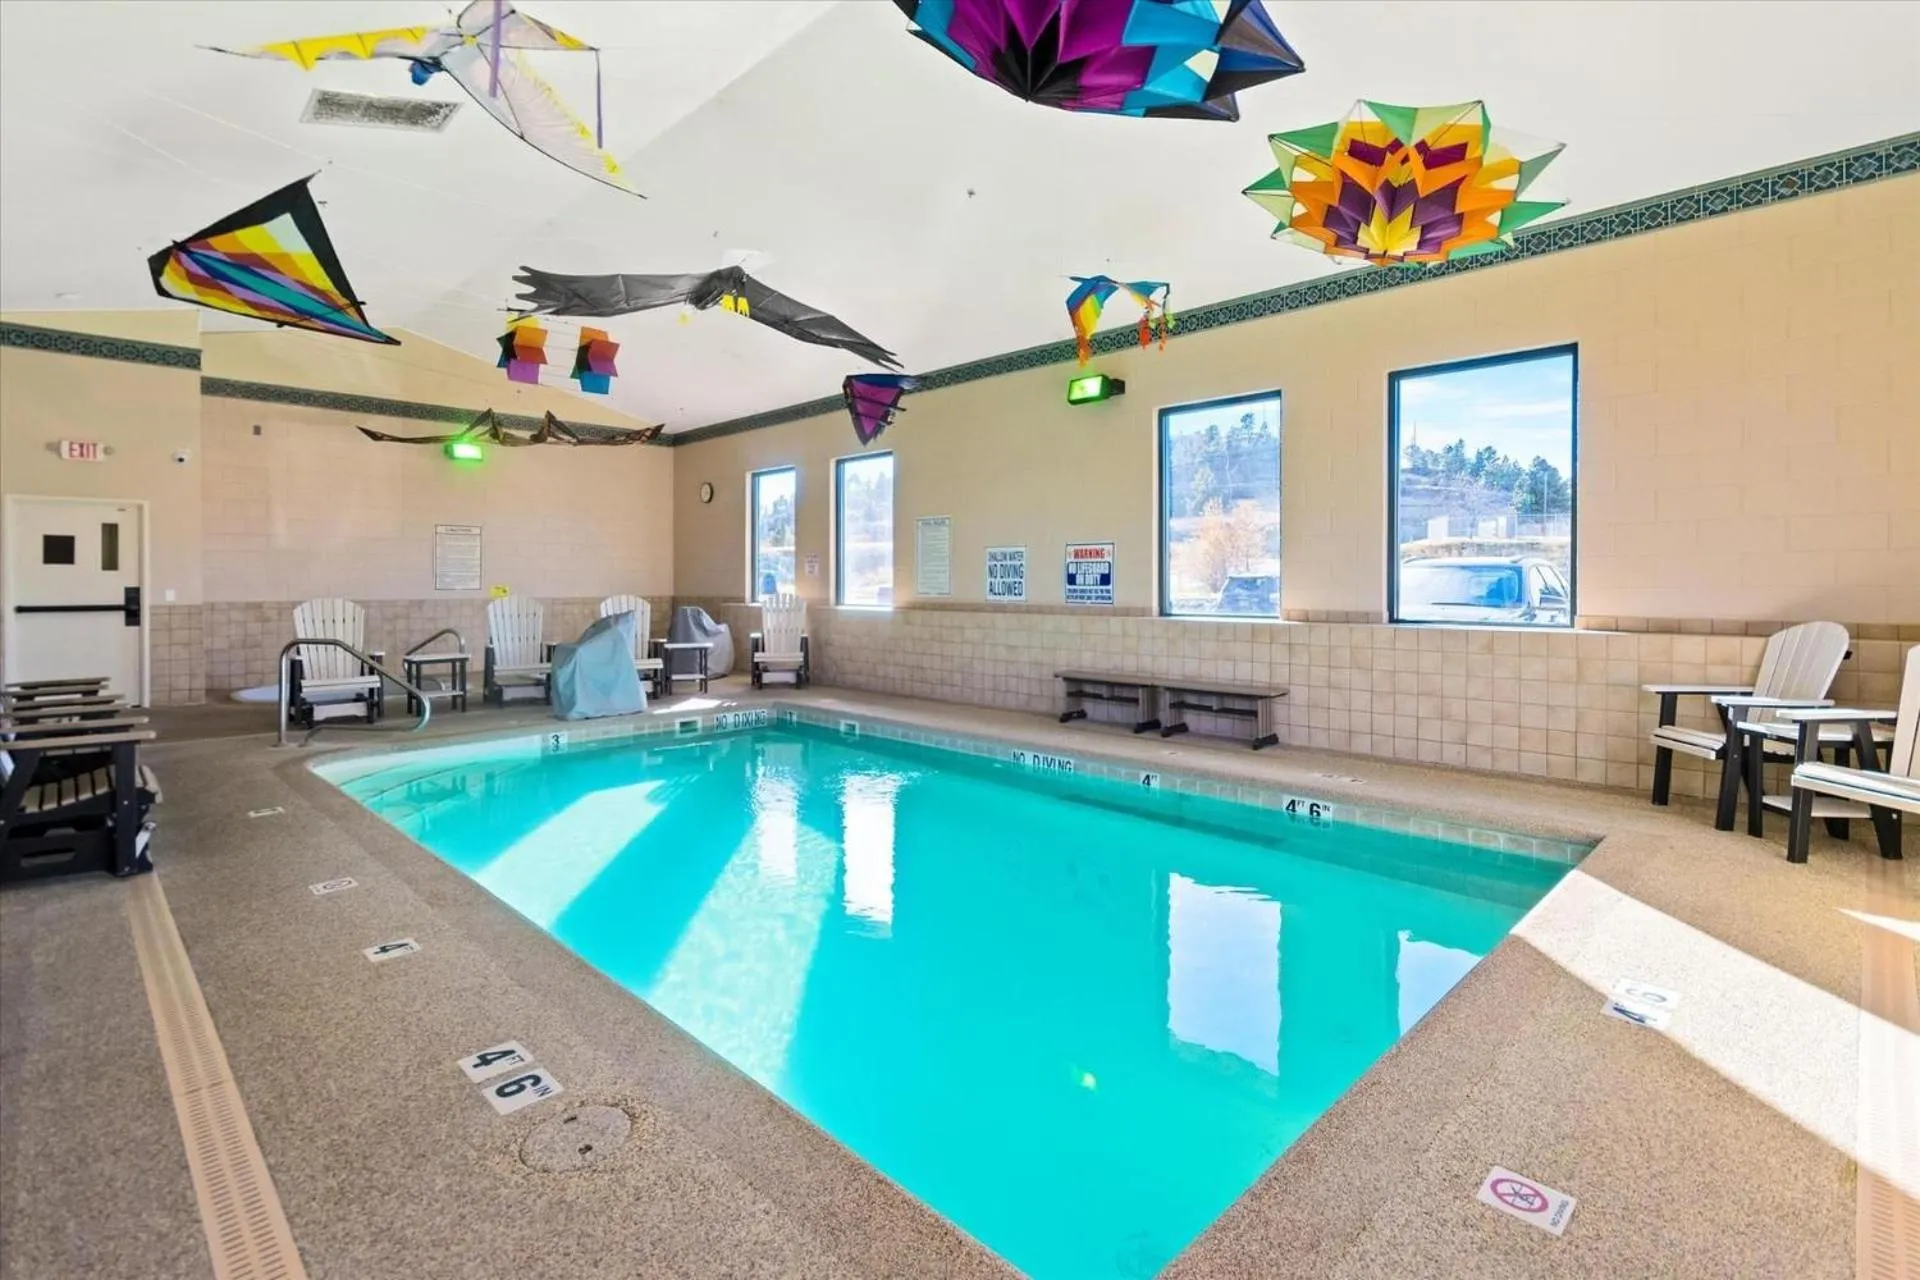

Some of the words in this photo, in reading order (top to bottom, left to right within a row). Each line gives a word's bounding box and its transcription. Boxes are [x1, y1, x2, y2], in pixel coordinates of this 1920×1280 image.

[68, 441, 98, 458] EXIT
[1073, 548, 1105, 559] WARNING
[988, 563, 998, 579] NO
[1000, 563, 1024, 579] DIVING
[989, 580, 1023, 597] ALLOWED
[716, 715, 727, 729] NO
[552, 734, 560, 745] 3
[1013, 751, 1025, 764] NO
[1033, 754, 1072, 772] DIVING
[472, 1049, 517, 1069] 4
[495, 1074, 542, 1098] 6
